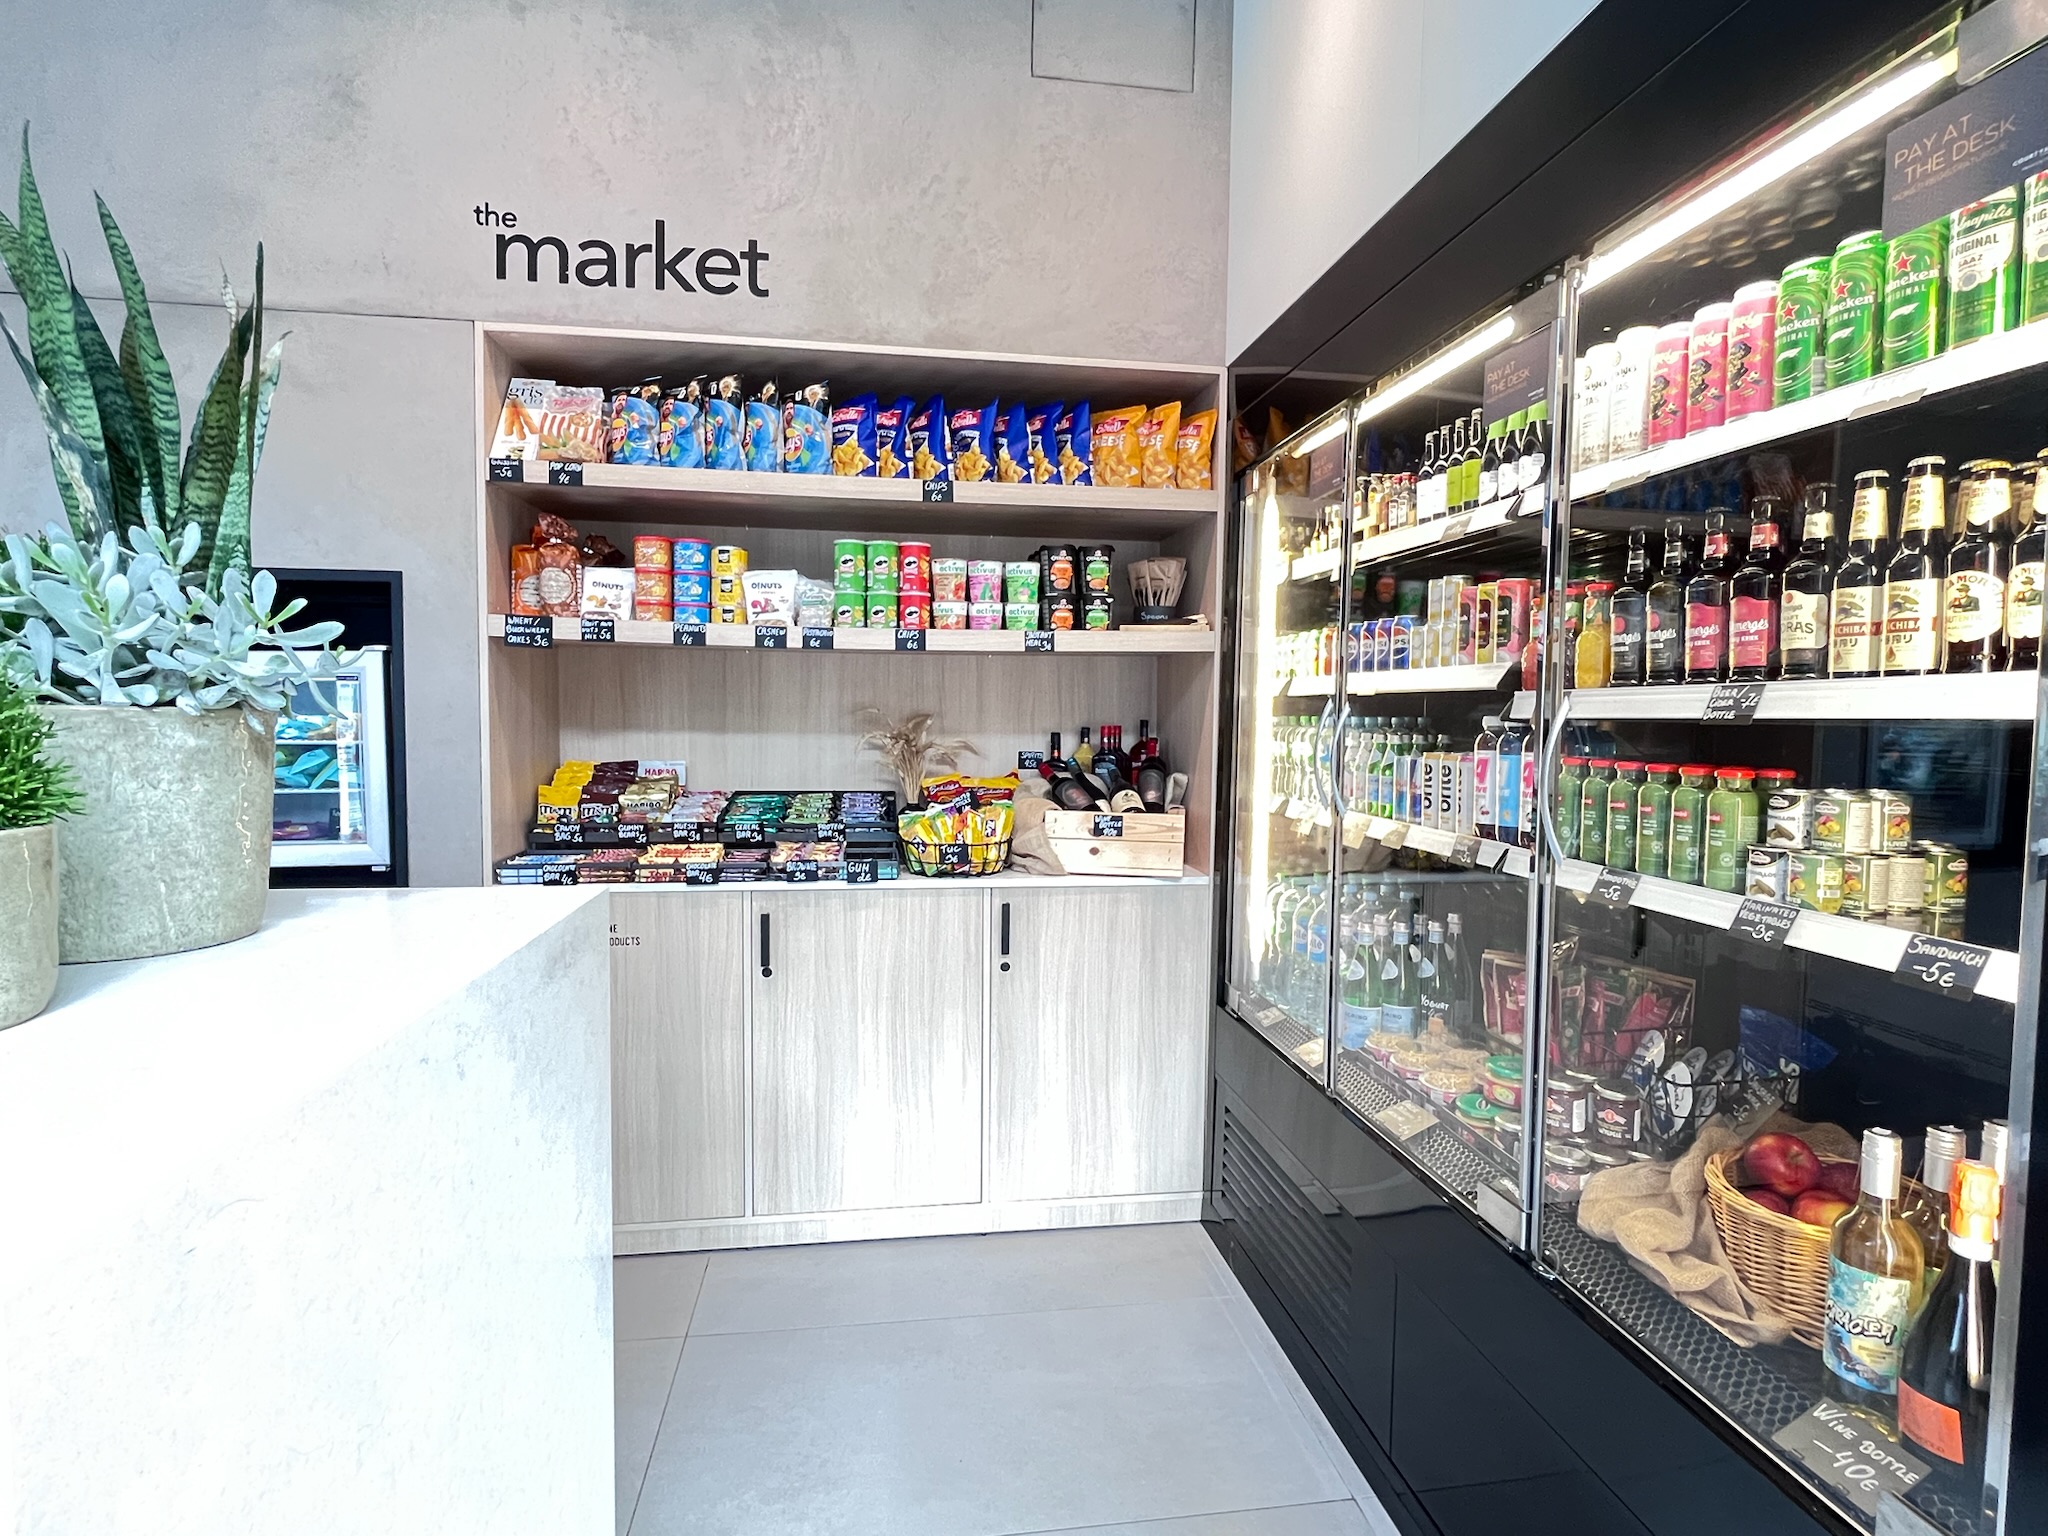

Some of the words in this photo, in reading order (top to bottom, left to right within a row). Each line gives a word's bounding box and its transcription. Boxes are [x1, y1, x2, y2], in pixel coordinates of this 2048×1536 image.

[1894, 131, 1938, 170] PAY
[1942, 112, 1973, 145] AT
[1904, 149, 1946, 184] THE
[1952, 114, 2017, 162] DESK
[473, 202, 517, 228] the
[1951, 233, 1999, 259] RIGINAL
[496, 219, 770, 298] market
[550, 462, 564, 471] POP
[924, 481, 948, 491] CHIPS
[934, 604, 954, 614] tivus
[673, 623, 707, 633] PEANUTS
[756, 627, 787, 637] CASHEW
[897, 629, 920, 639] CHIPS
[1702, 708, 1736, 720] BOTTLE
[940, 844, 962, 855] TUC
[847, 861, 870, 874] GUM
[609, 936, 641, 947] ODUCTS
[1912, 961, 1957, 989] -5€
[1859, 1440, 1920, 1485] BOTTLE
